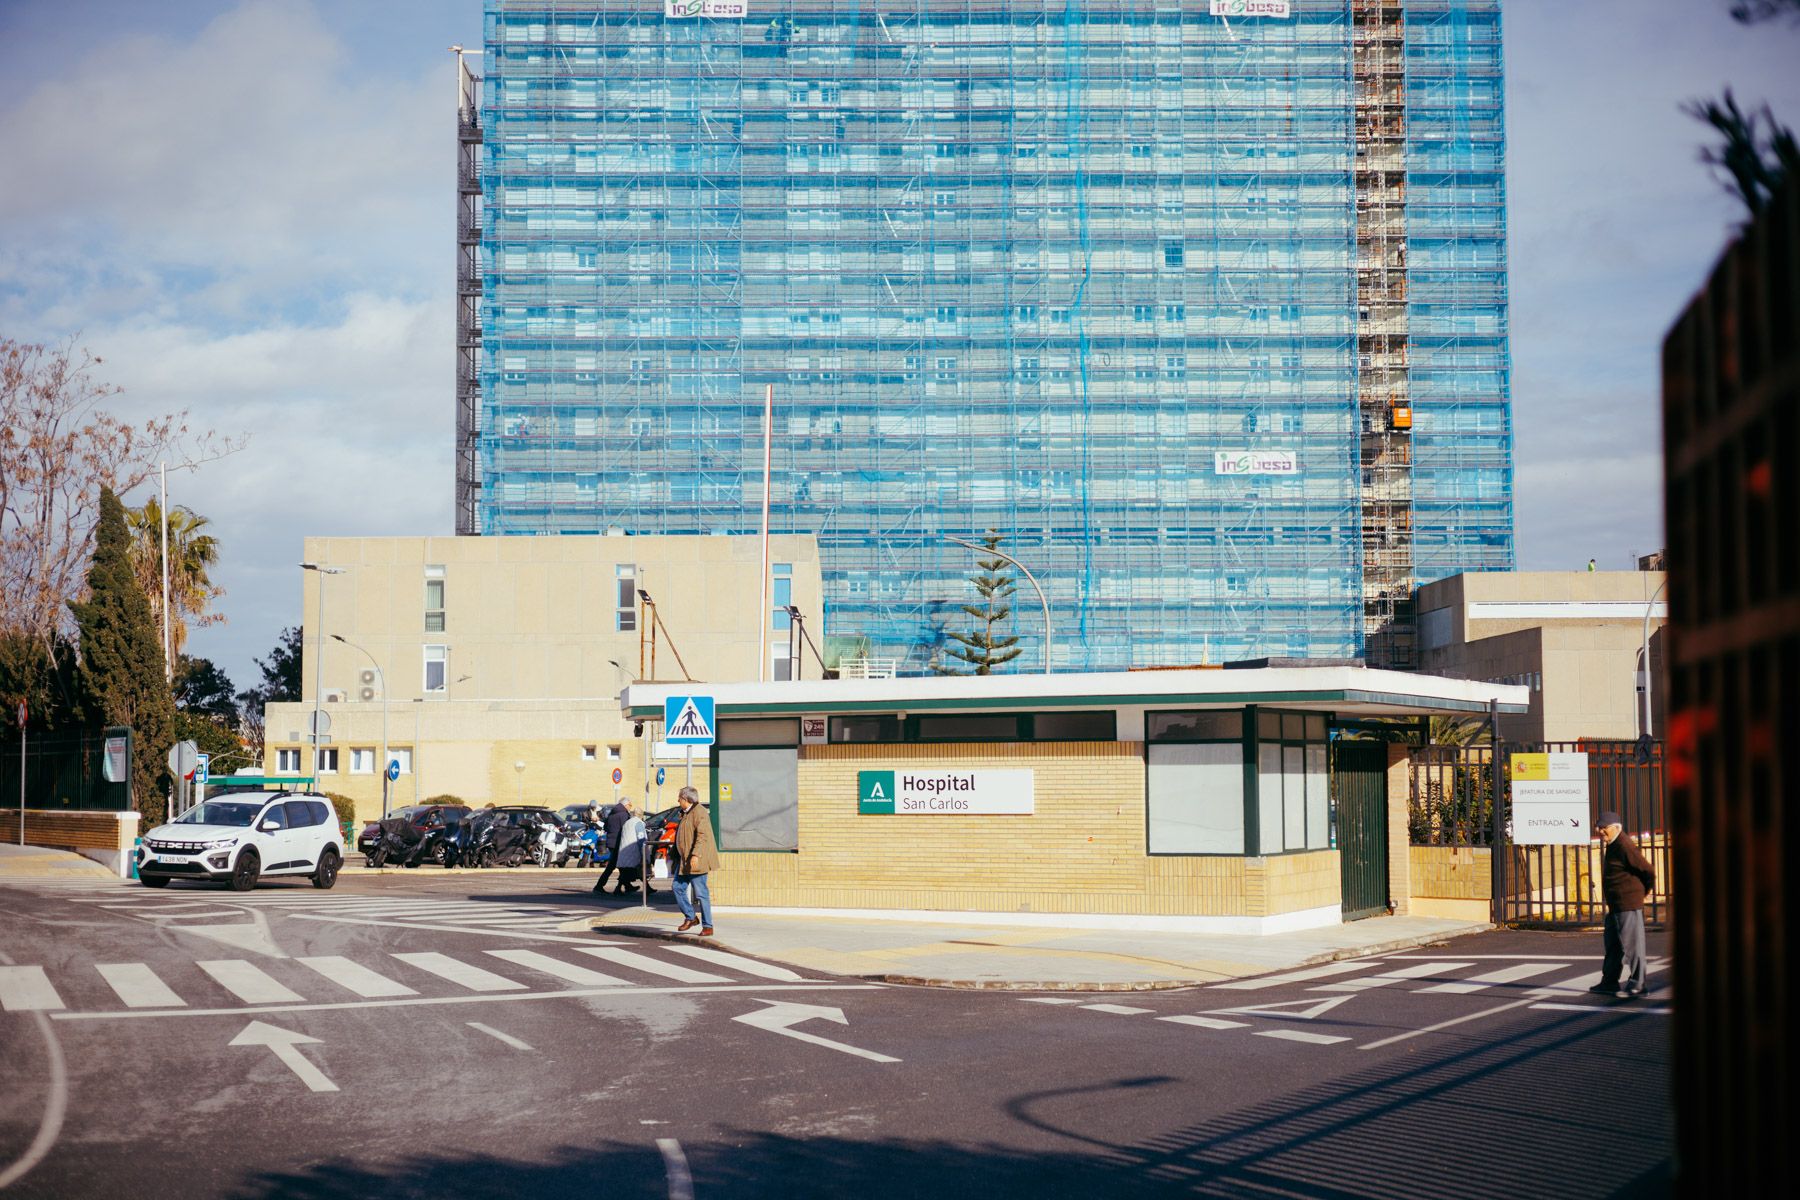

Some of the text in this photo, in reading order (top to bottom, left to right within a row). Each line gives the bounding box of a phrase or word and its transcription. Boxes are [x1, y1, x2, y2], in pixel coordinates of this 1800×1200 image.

[903, 774, 976, 795] Hospital
[903, 797, 969, 810] San Carlos
